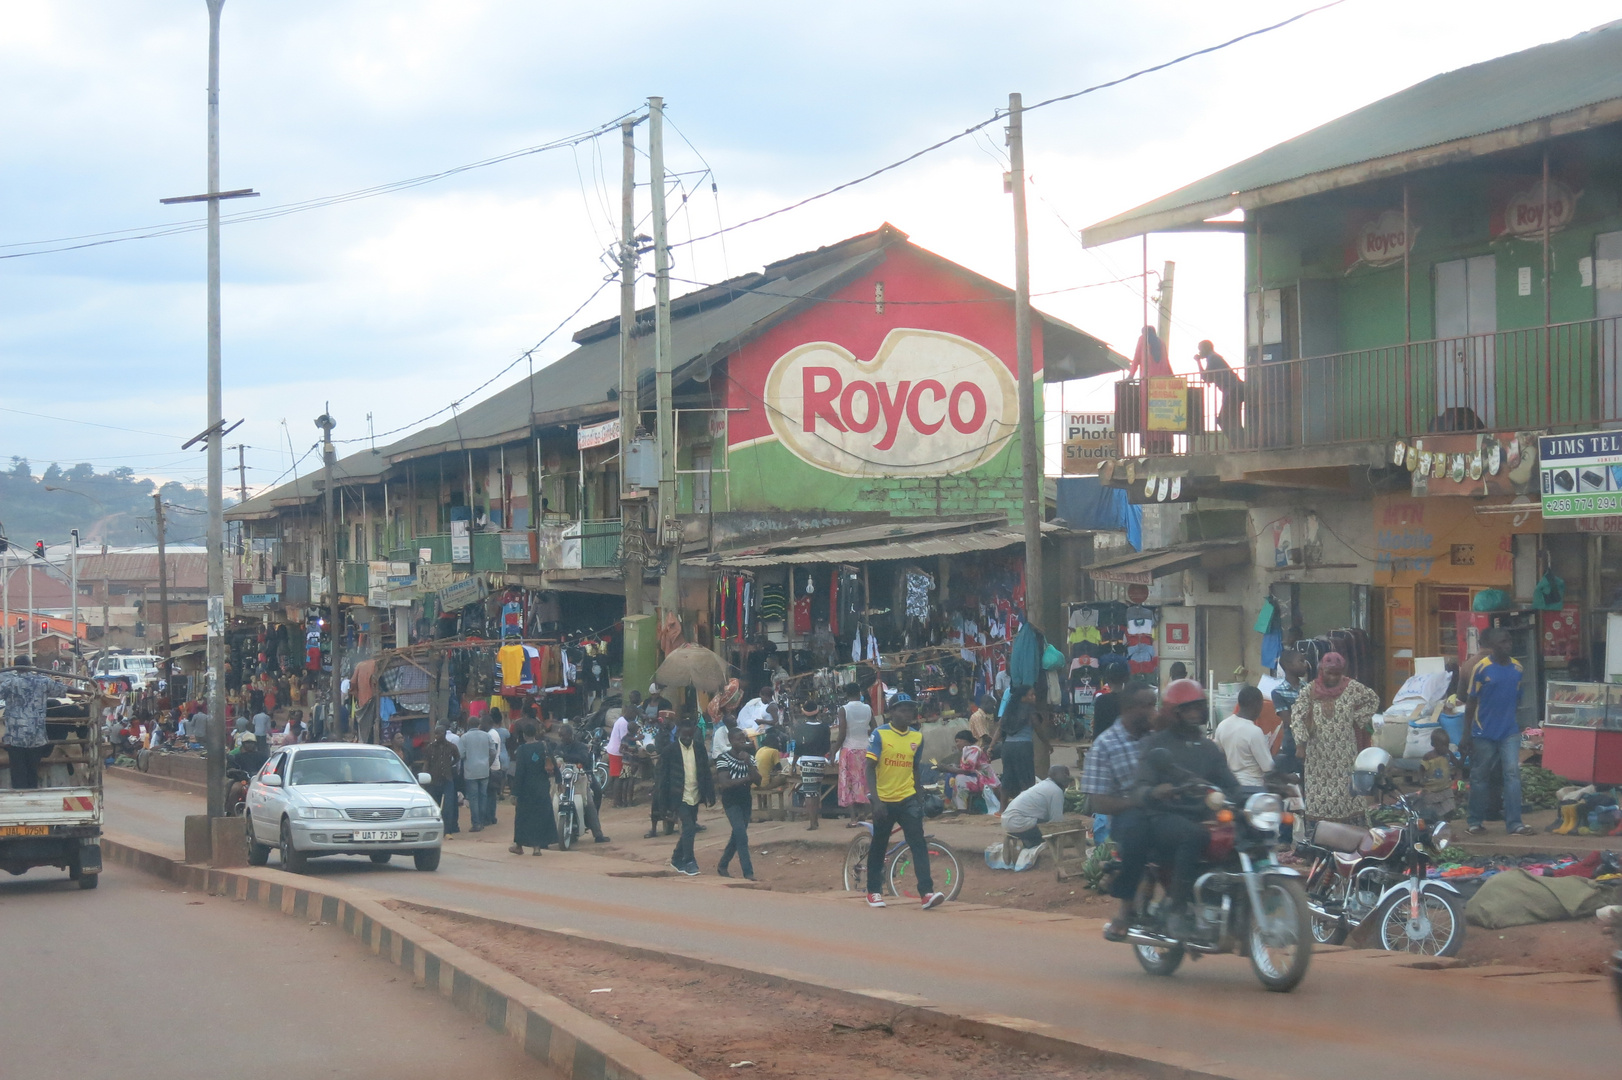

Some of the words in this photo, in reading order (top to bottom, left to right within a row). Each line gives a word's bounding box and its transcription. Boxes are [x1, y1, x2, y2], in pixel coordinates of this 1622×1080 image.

[1366, 231, 1405, 254] Royco
[802, 366, 987, 451] Royco
[1071, 414, 1111, 425] MIISI
[1068, 426, 1116, 440] Photo
[1066, 445, 1117, 458] Studio
[1550, 438, 1584, 456] JIMS
[1590, 435, 1622, 453] TEL
[1546, 499, 1571, 512] +256
[1575, 498, 1594, 511] 774
[1597, 497, 1617, 509] 294
[1383, 503, 1424, 525] MTN
[1578, 517, 1599, 531] MILK
[1377, 528, 1433, 549] Mobile
[1375, 552, 1435, 576] Money
[6, 826, 21, 835] UAL
[362, 831, 377, 839] UAT
